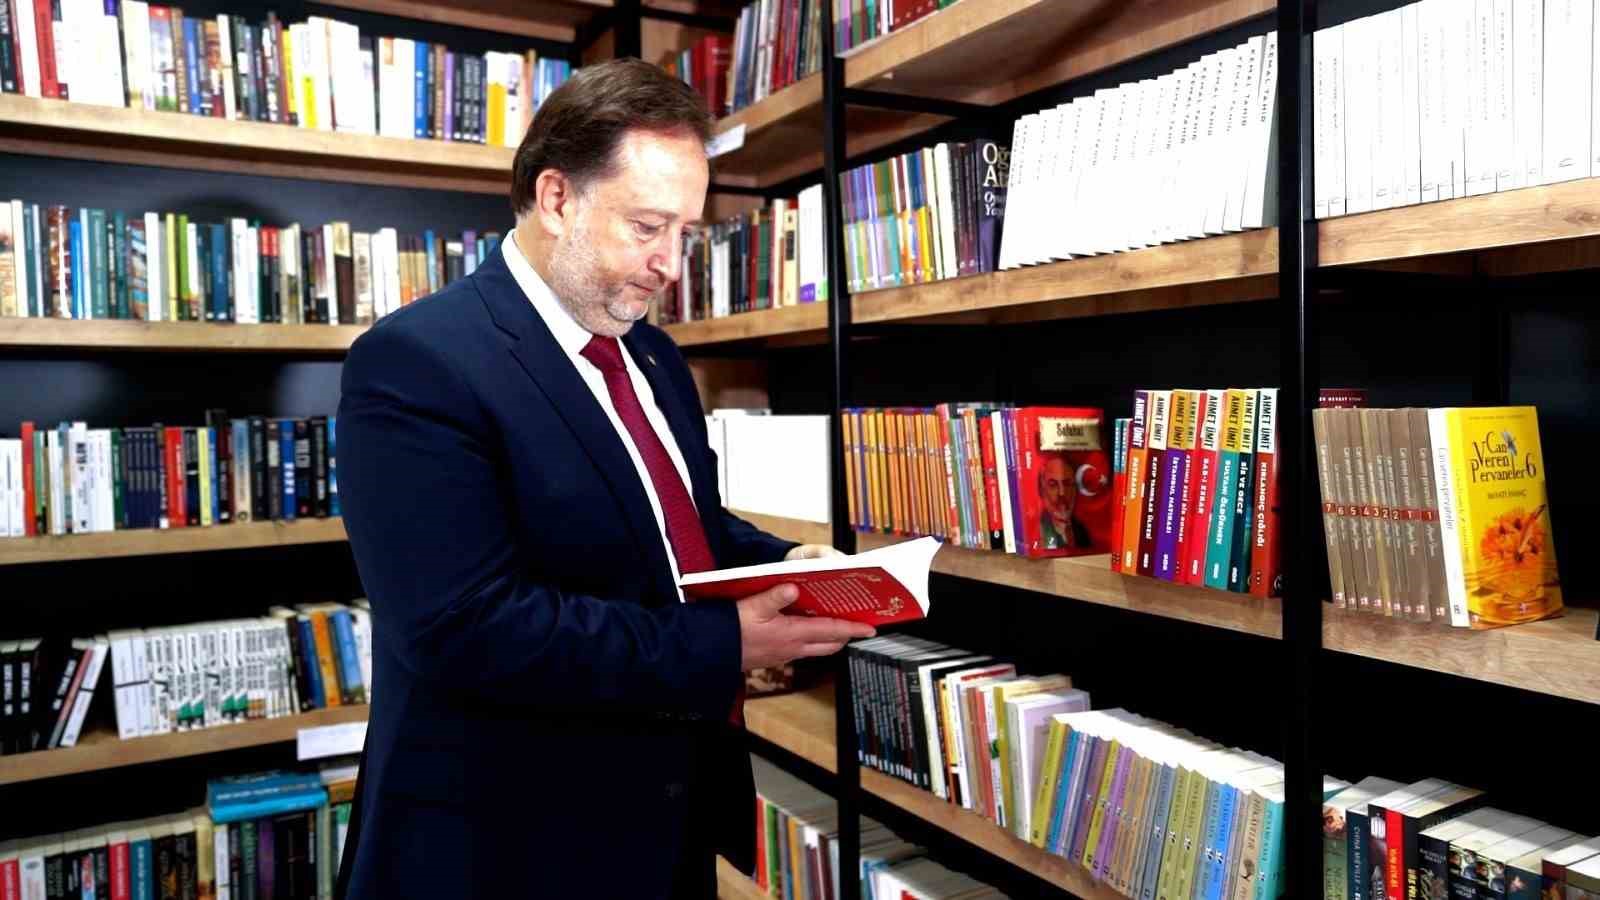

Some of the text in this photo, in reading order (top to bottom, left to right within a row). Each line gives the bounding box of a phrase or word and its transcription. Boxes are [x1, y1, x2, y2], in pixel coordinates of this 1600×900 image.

[1134, 398, 1144, 425] AHMET
[1156, 397, 1164, 421] AHMET
[1176, 396, 1186, 423] AHMET
[1207, 395, 1218, 423] AHMET
[1230, 396, 1240, 424] AHMET
[1244, 396, 1253, 424] AHMET
[1262, 395, 1272, 424] AHMET
[1472, 441, 1510, 467] Veren
[1486, 430, 1507, 453] Can
[1526, 452, 1537, 479] 6
[1239, 478, 1244, 488] VE
[1258, 463, 1267, 510] KIRLANGIÇ
